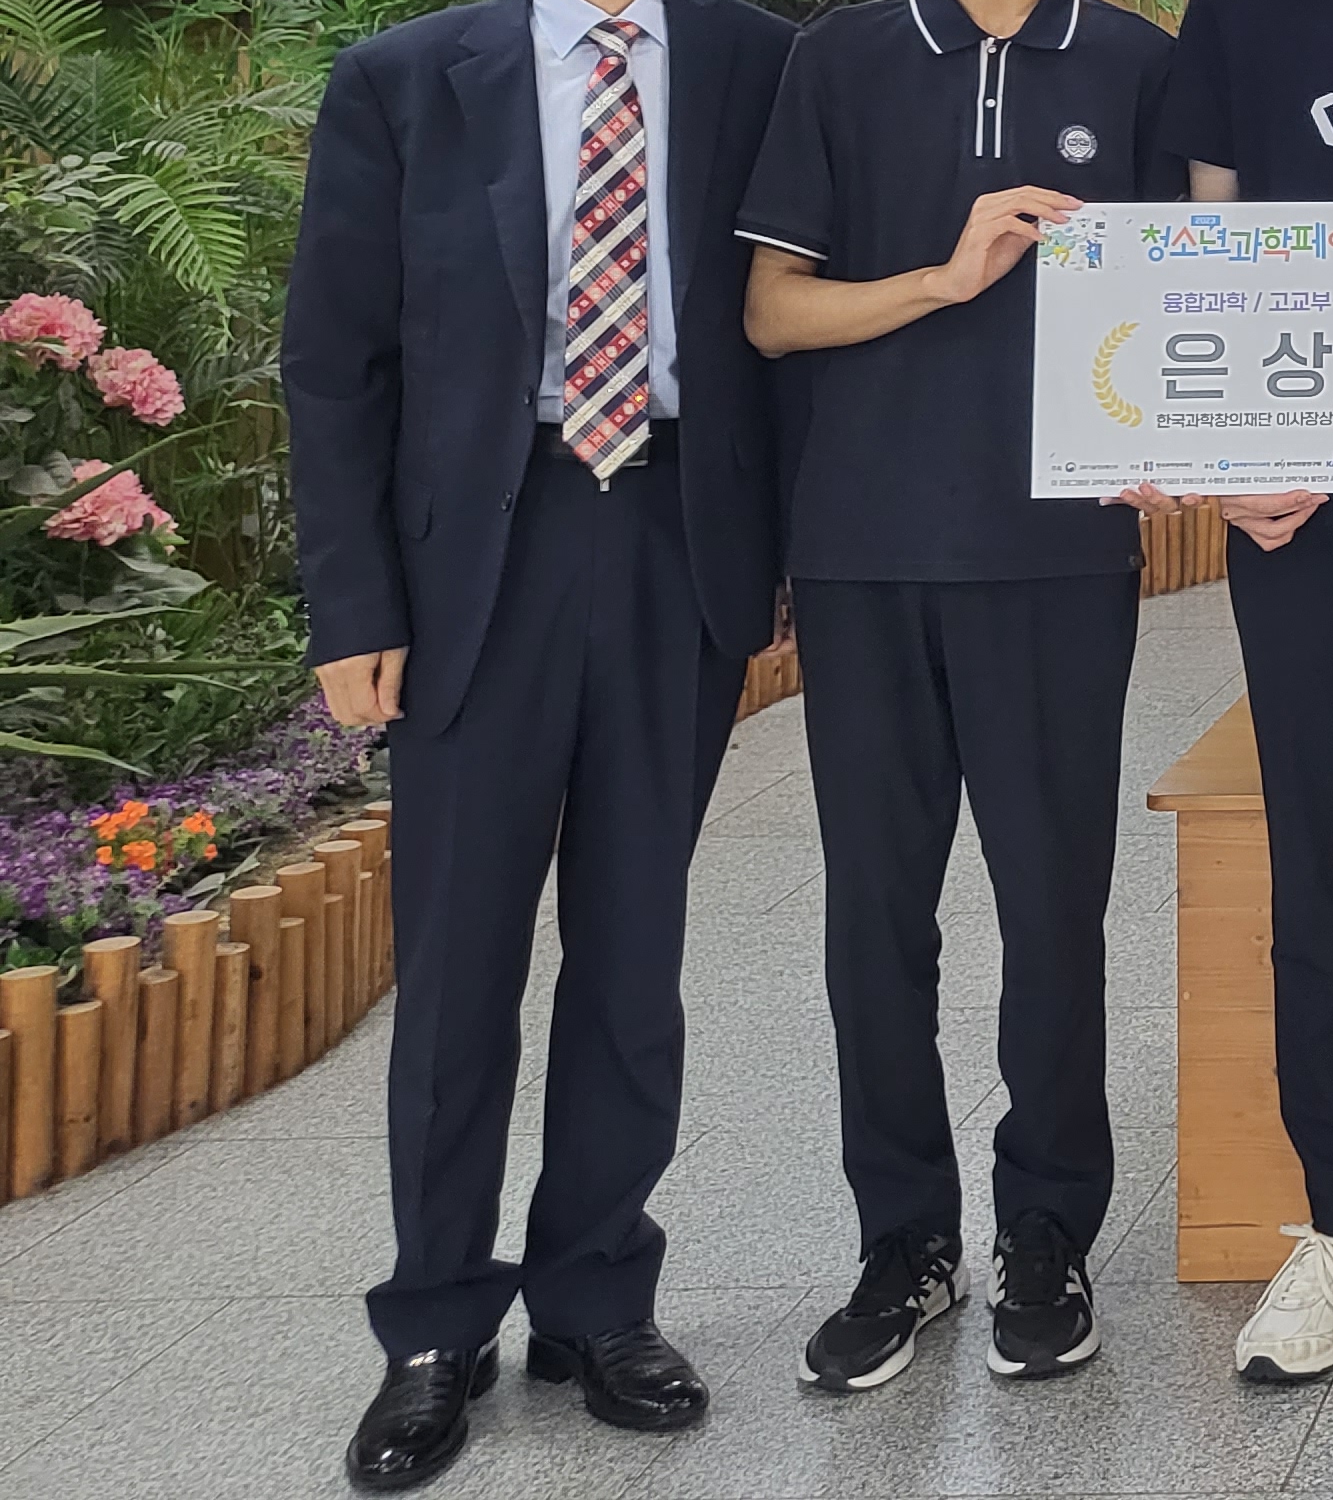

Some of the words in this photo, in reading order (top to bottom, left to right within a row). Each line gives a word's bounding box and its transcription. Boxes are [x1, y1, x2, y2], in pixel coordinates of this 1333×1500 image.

[1162, 291, 1248, 314] 융합과학
[1269, 291, 1331, 312] 고교부
[1161, 332, 1228, 399] 은
[1262, 331, 1332, 398] 상
[1156, 412, 1272, 429] 한국과학창의재단
[1276, 410, 1333, 427] 이사장상
